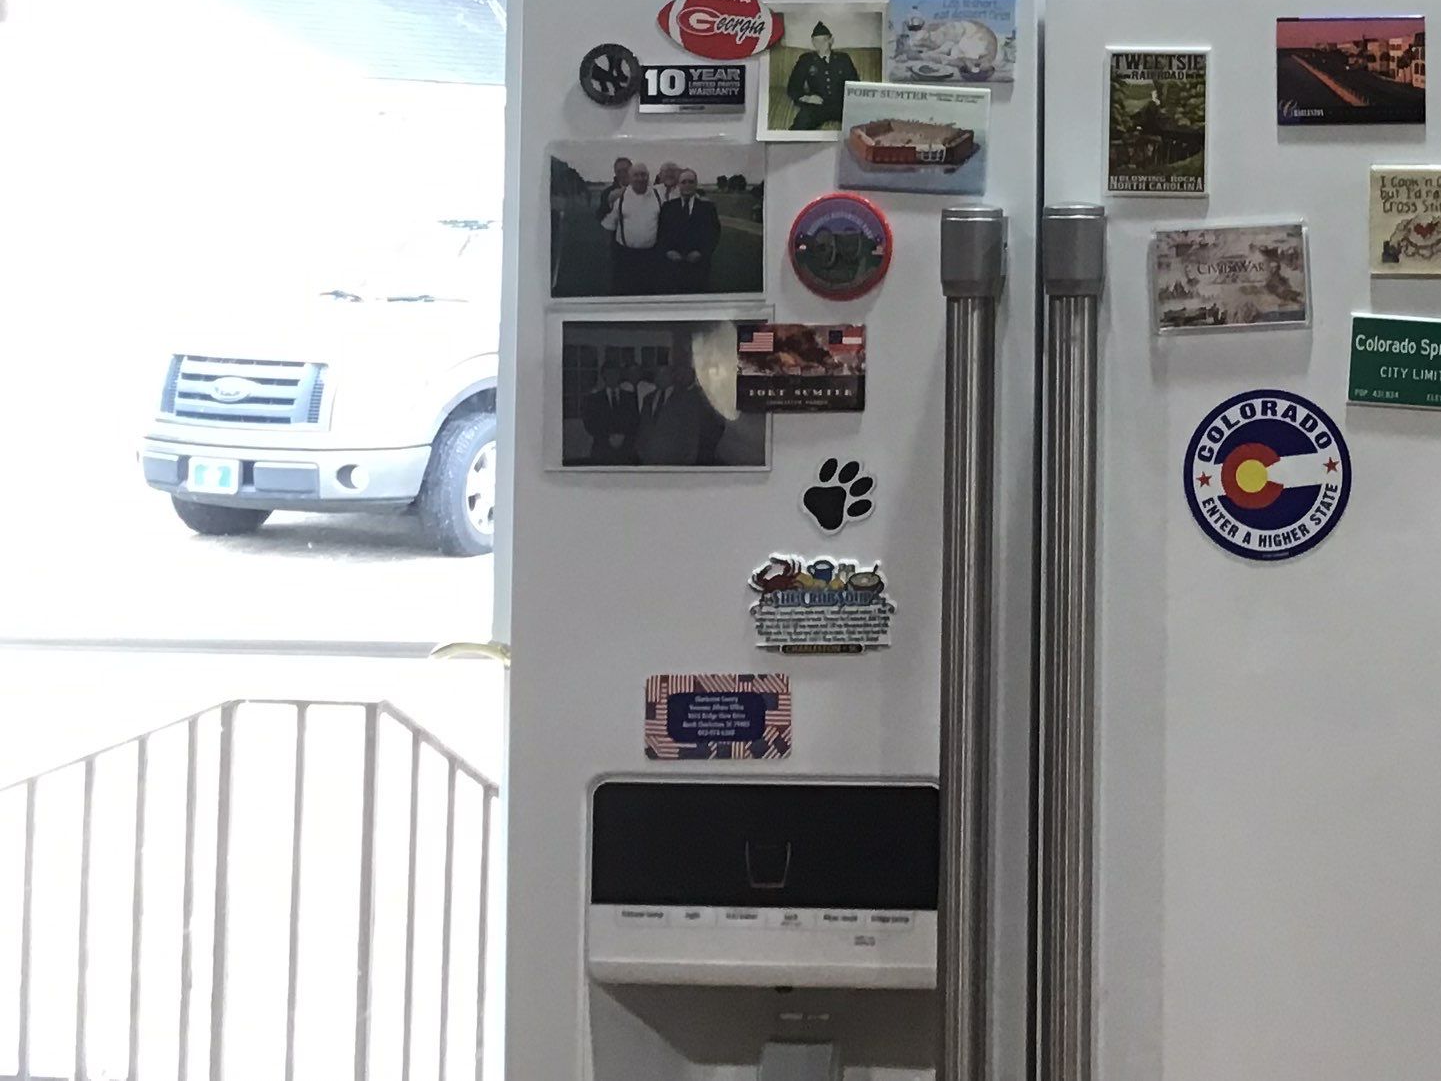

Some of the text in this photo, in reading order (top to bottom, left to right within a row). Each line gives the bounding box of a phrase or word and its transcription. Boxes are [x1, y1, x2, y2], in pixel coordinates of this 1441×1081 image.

[688, 11, 766, 41] Georgia
[1113, 54, 1204, 70] TWEETSIE
[645, 69, 740, 96] 10 YEAR
[689, 87, 739, 96] WARRANTY
[847, 88, 878, 98] FORT
[880, 89, 928, 100] SUMTER
[1110, 176, 1204, 191] NORTH CAROLINA
[1381, 176, 1386, 187] I
[1391, 176, 1419, 187] Cook
[1381, 188, 1399, 199] but
[1383, 200, 1417, 213] Cross
[1355, 334, 1417, 354] Colorado
[1380, 366, 1409, 379] CITY
[1355, 388, 1368, 396] POP
[1197, 400, 1333, 463] COLORADO
[1202, 483, 1338, 547] ENTER A HIGHER STATE
